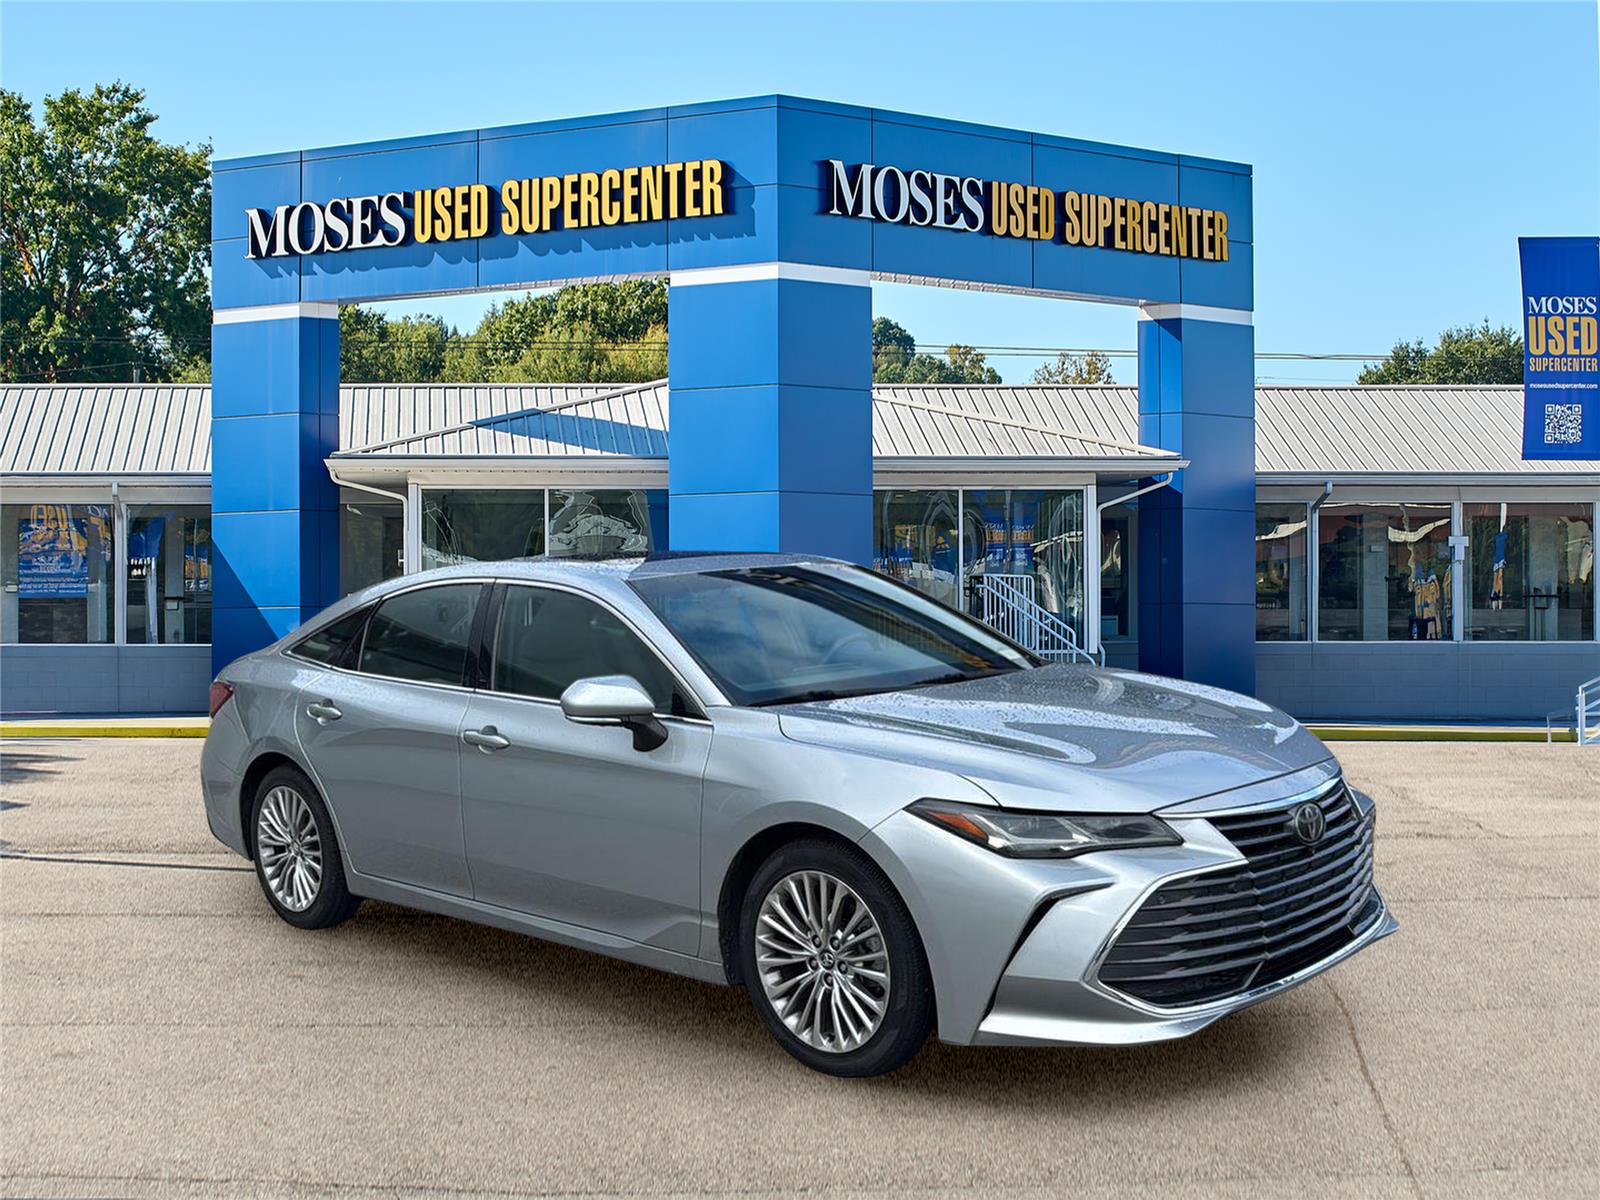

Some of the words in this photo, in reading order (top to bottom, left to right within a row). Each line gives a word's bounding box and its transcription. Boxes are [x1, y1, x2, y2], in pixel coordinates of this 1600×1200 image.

[245, 192, 406, 260] MOSES
[413, 183, 489, 244] USED
[501, 158, 724, 236] SUPERCENTER
[829, 159, 985, 232] MOSES
[991, 180, 1055, 241] USED
[1065, 190, 1229, 261] SUPERCENTER
[1527, 296, 1597, 314] MOSES
[1528, 315, 1598, 356] USED
[1529, 357, 1598, 372] SUPERCENTER
[1529, 382, 1598, 390] mosesusedsupercenter.com
